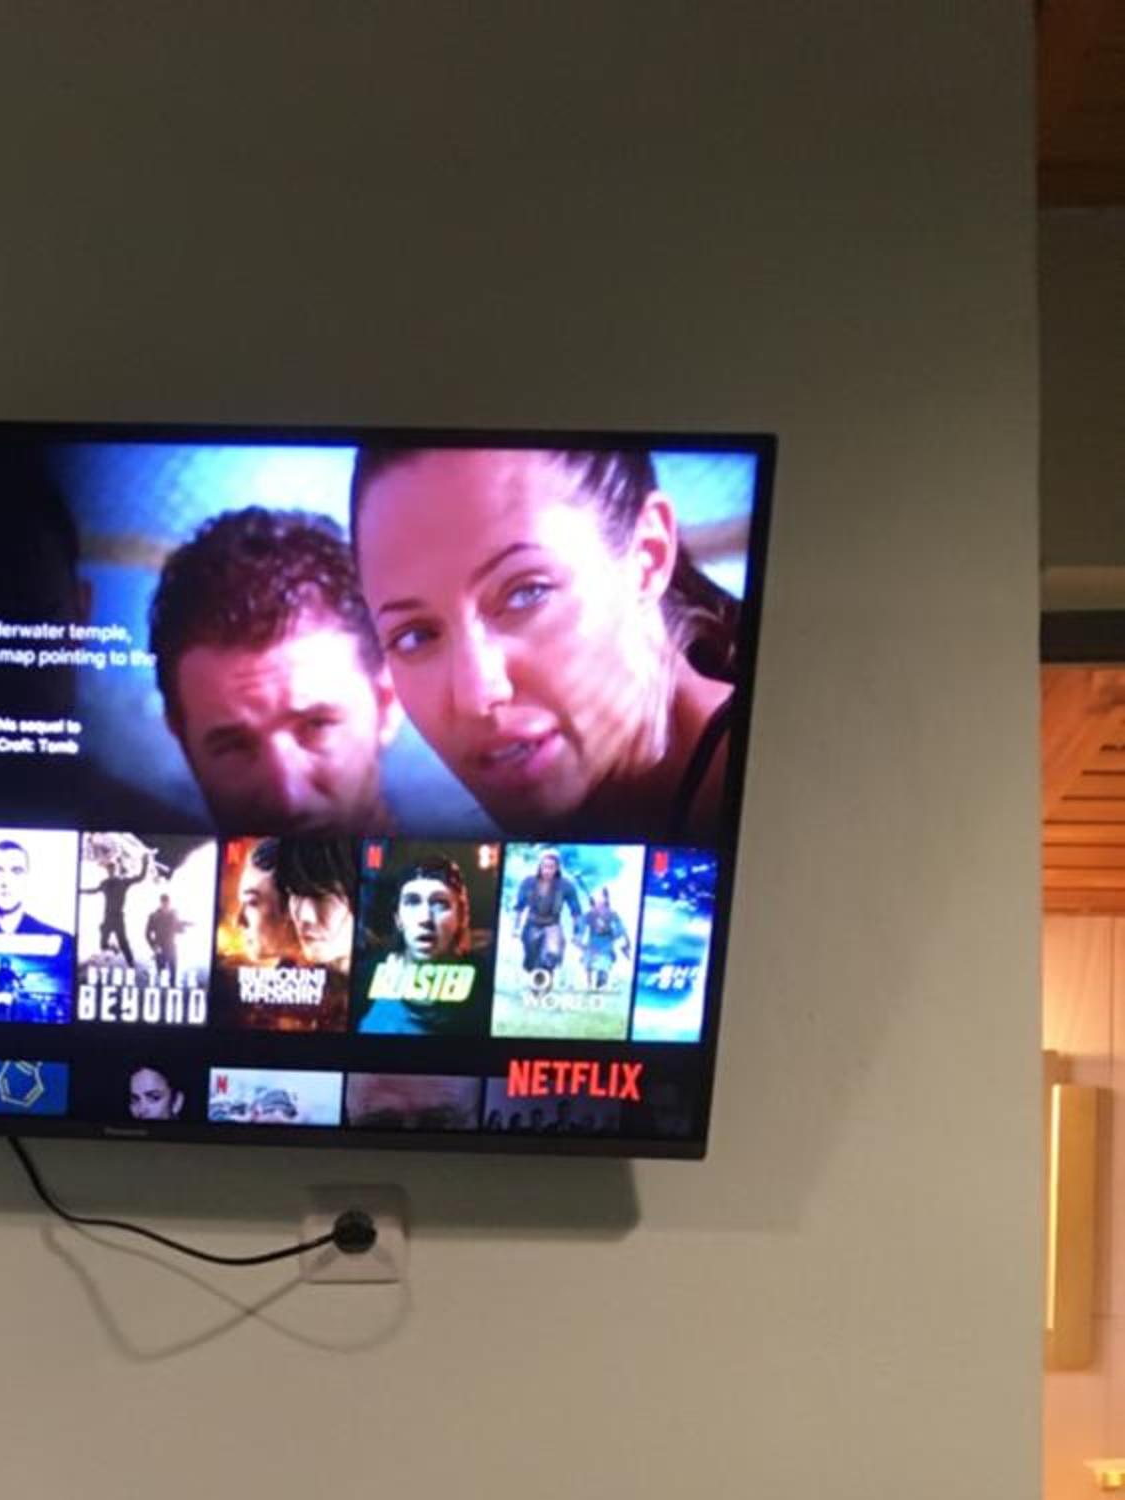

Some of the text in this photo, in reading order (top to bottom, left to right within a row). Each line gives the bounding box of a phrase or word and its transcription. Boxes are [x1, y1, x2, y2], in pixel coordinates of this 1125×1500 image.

[69, 623, 133, 644] temple,
[38, 647, 107, 670] pointing
[109, 649, 128, 666] to
[130, 649, 157, 667] the
[19, 718, 65, 736] sequel
[67, 719, 83, 735] to
[37, 737, 79, 755] Tomb
[77, 985, 208, 1024] BEYOND
[506, 1058, 643, 1101] NETFLIX
